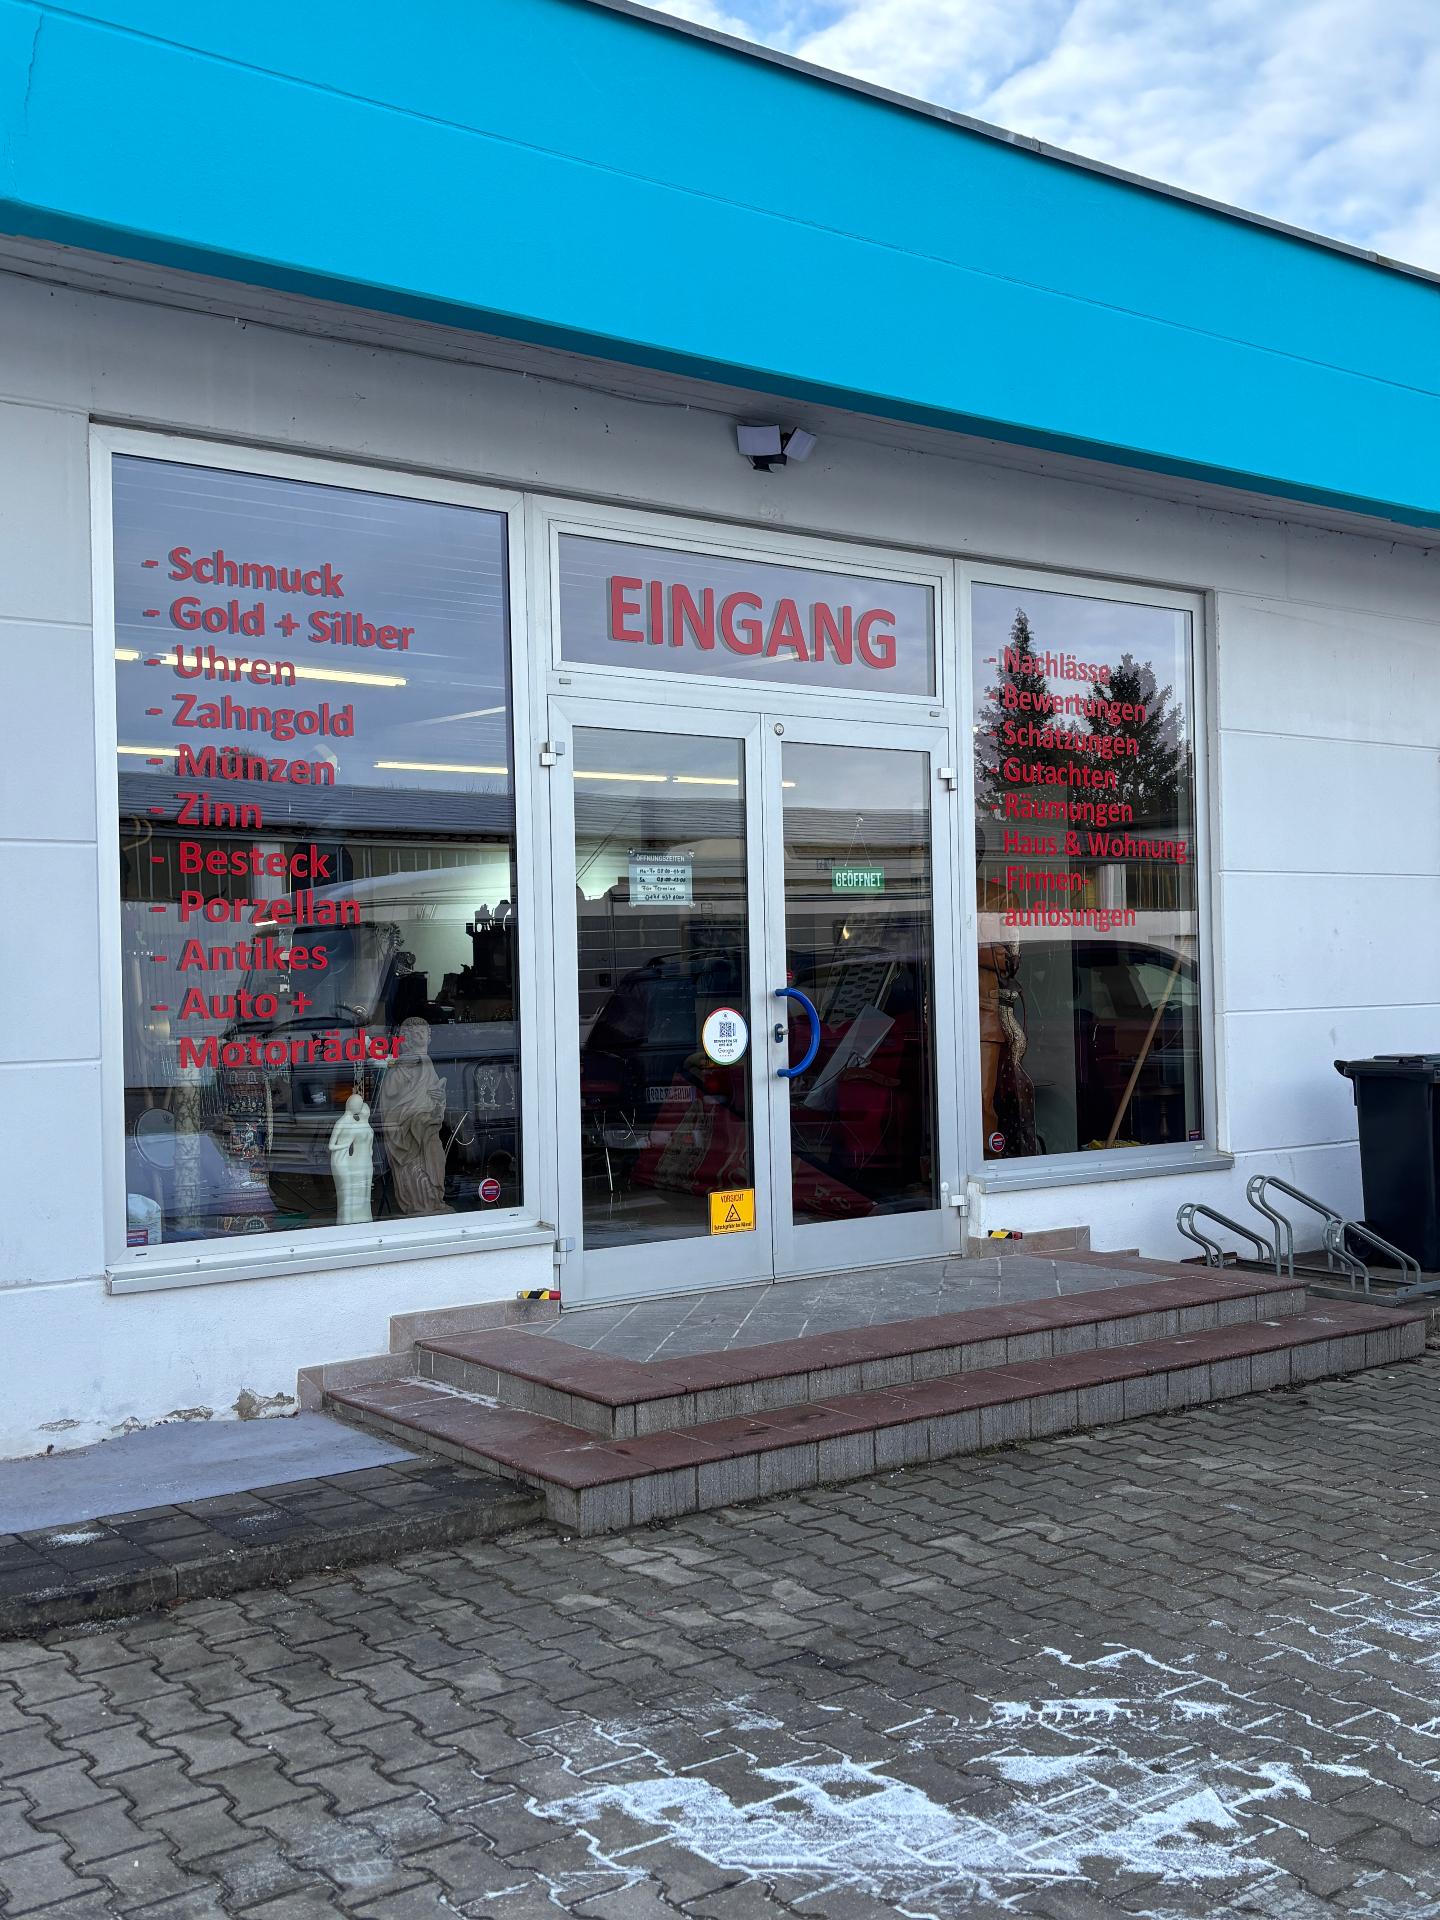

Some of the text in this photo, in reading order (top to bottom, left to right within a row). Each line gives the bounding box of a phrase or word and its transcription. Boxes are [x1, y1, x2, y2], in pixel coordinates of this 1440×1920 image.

[169, 546, 345, 598] Schmuck
[171, 596, 265, 636] Gold
[275, 613, 300, 636] +
[309, 610, 415, 650] Silber
[610, 574, 897, 670] EINGANG
[176, 645, 296, 686] Uhren
[1003, 646, 1112, 684] Nachlässe
[173, 694, 354, 741] Zahngold
[1004, 684, 1146, 725] Bewertungen
[1004, 721, 1138, 760] Schätzungen
[178, 744, 335, 786] Münzen
[1004, 757, 1116, 789] Gutachten
[176, 793, 263, 829] Zinn
[1005, 793, 1133, 827] Räumungen
[179, 842, 331, 878] Besteck
[1005, 831, 1187, 864] Haus & Wohnung
[835, 870, 881, 887] GEÖFFNET
[1007, 866, 1089, 892] Firmen-
[180, 890, 361, 925] Porzellan
[1005, 902, 1136, 932] auflösungen
[180, 938, 329, 971] Antikes
[180, 987, 278, 1020] Auto
[291, 991, 313, 1016] +
[180, 1030, 405, 1069] Motorräder
